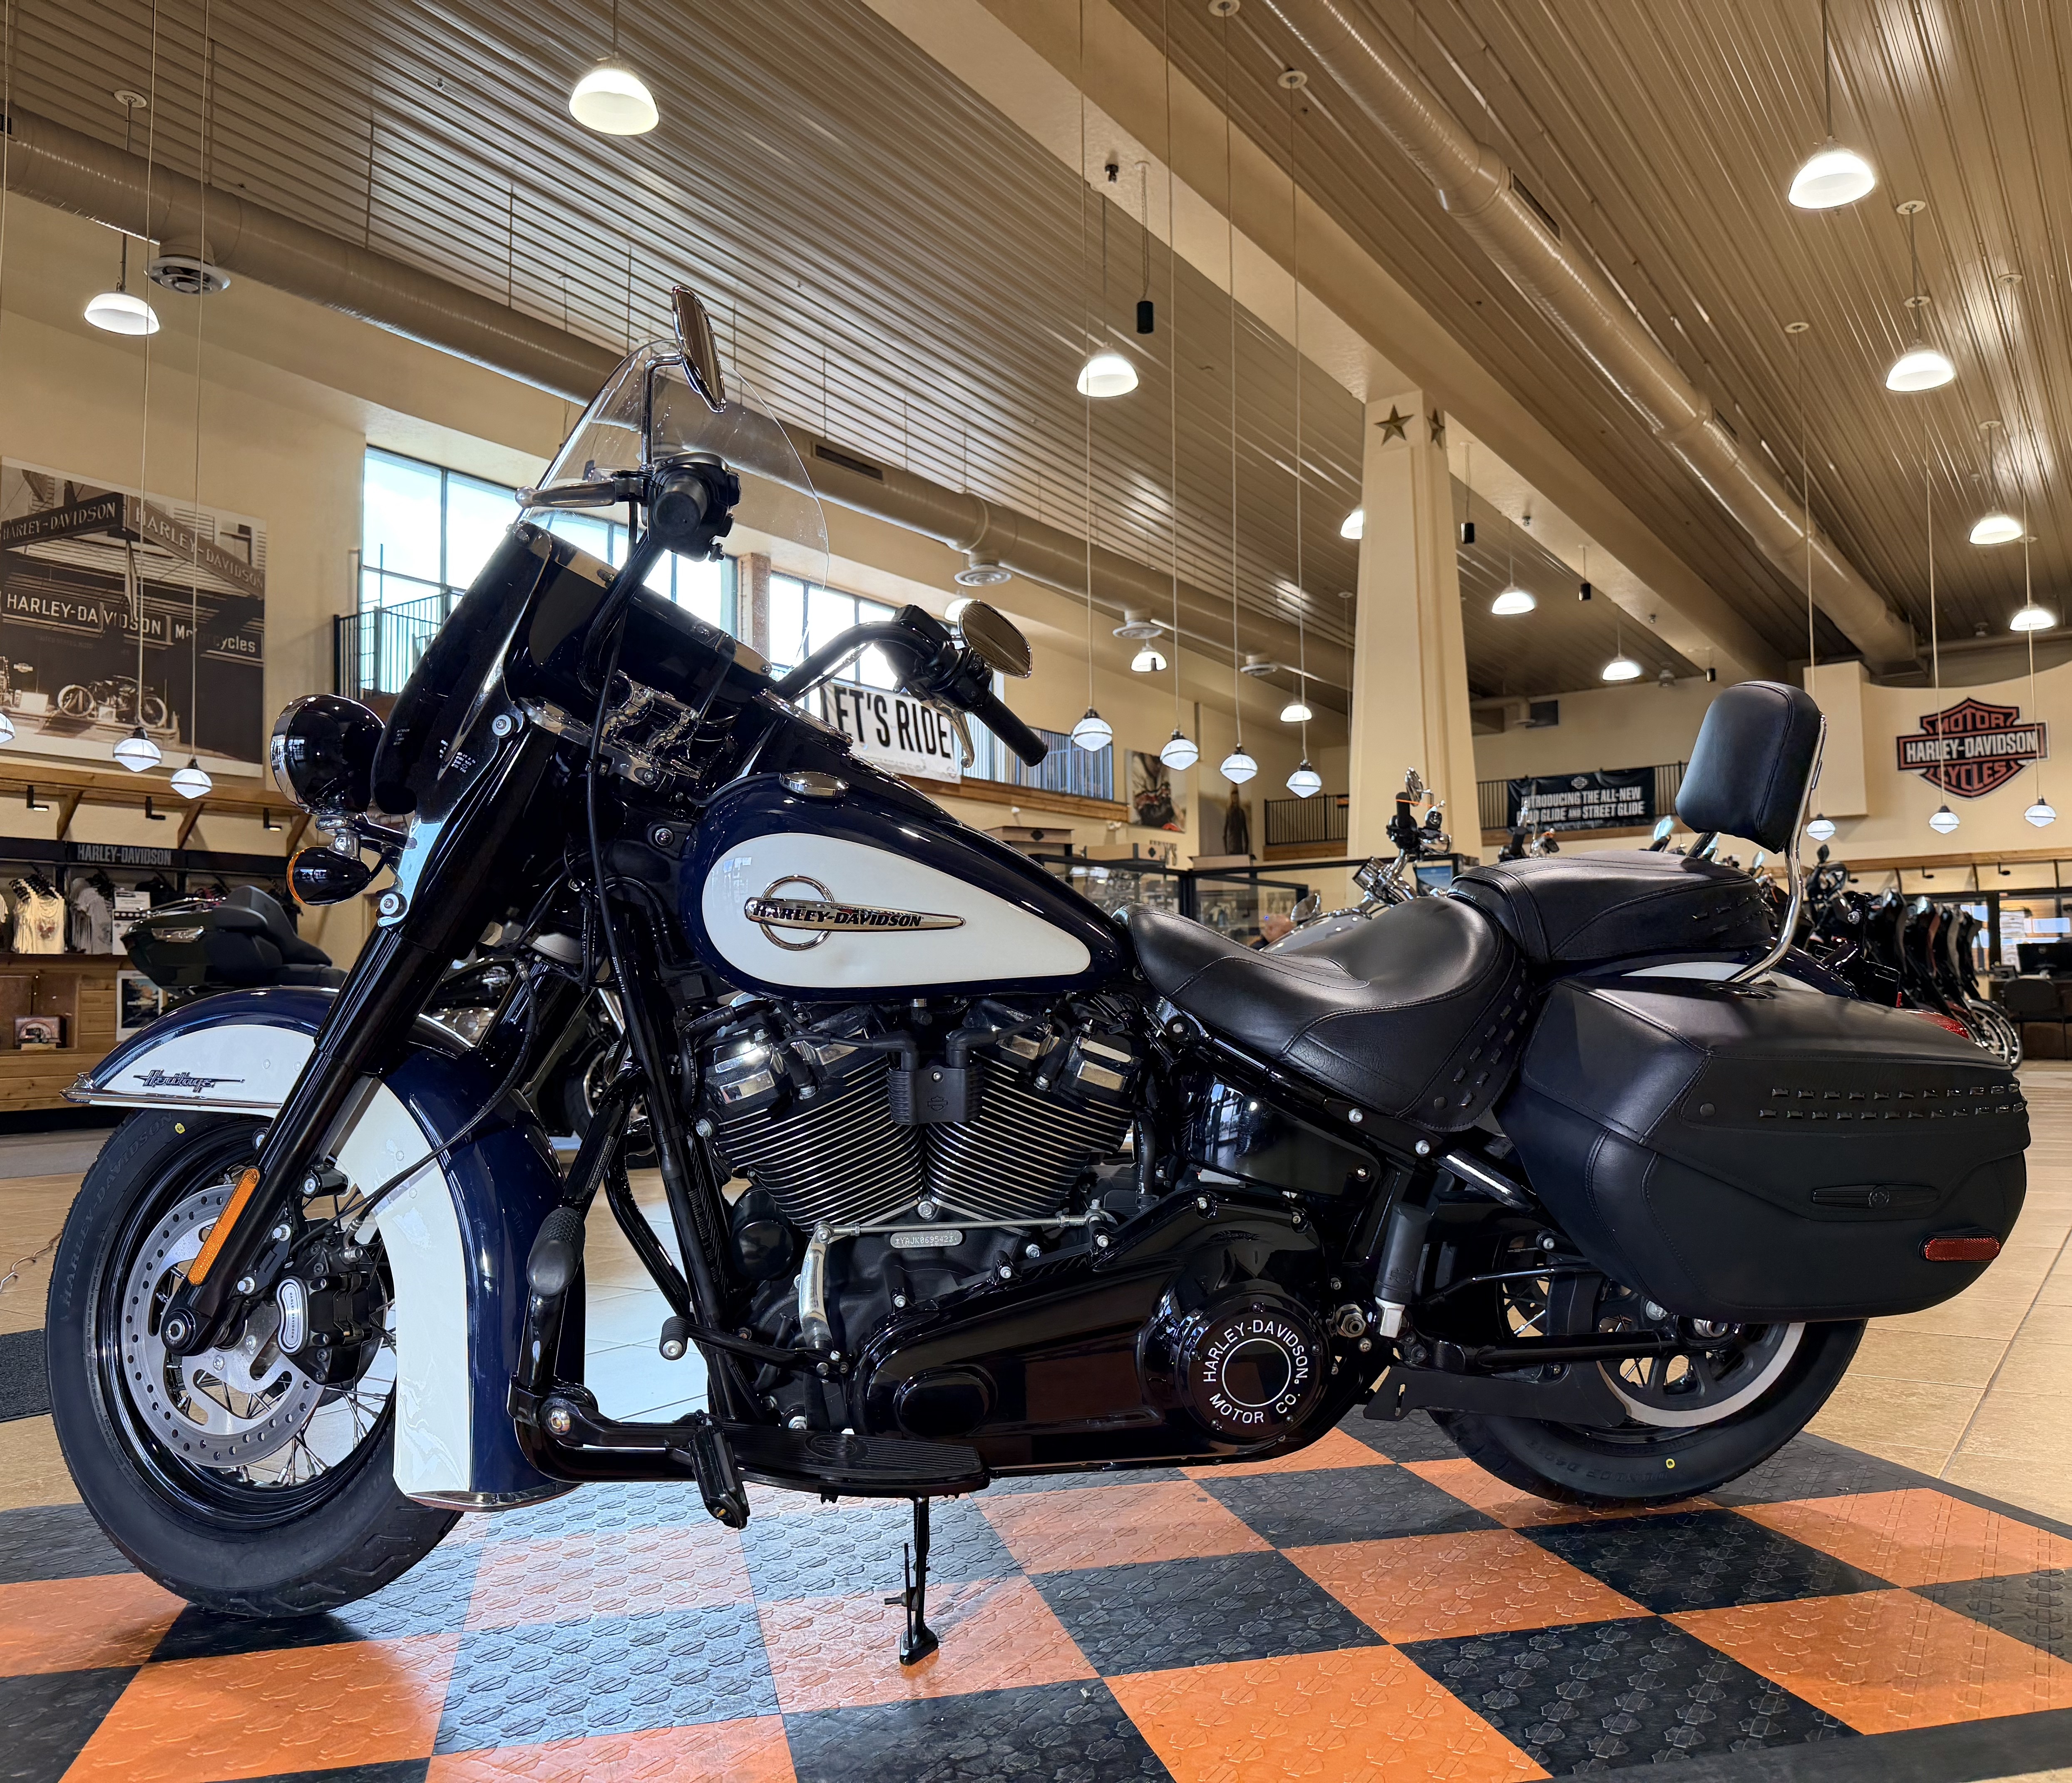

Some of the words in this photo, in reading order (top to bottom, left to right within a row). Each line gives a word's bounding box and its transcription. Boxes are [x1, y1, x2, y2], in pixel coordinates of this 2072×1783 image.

[3, 502, 116, 540] HARLEY-DAVIDSON
[135, 507, 263, 589] HARLEY-DAVIDSON
[7, 594, 161, 635] HARLEY-DAVIDSON
[896, 700, 952, 759] RIDE
[1935, 707, 2005, 733] MOTOR
[1905, 730, 2037, 763] HARLEY-DAVIDSON
[1937, 760, 2007, 789] CYCLES
[1583, 790, 1599, 804] THE
[1600, 786, 1642, 802] ALL-NEW
[1540, 807, 1566, 822] GLIDE
[1568, 809, 1581, 818] AND
[1583, 803, 1616, 819] STREET
[1617, 801, 1645, 817] GLIDE
[77, 844, 171, 866] HARLEY-DAVIDSON
[753, 905, 922, 927] HARLEY-DAVIDSON
[143, 1069, 215, 1093] Heritage
[63, 1113, 173, 1309] HARLEY-DAVIDSON
[1203, 1319, 1309, 1383] HARLEY-DAVIDSON
[1209, 1393, 1265, 1424] MOTOR
